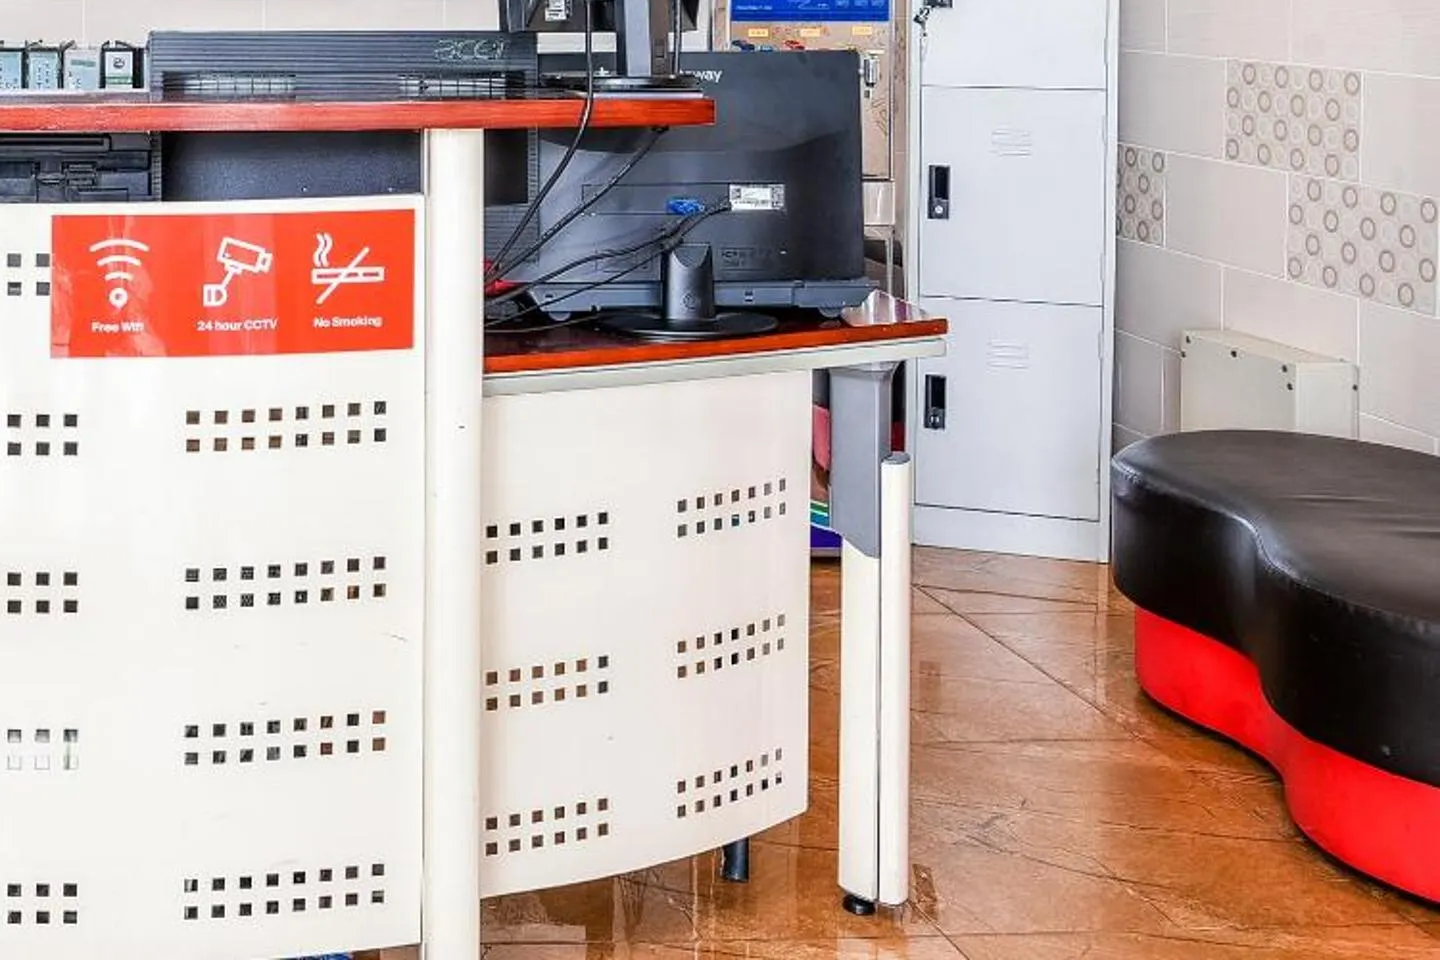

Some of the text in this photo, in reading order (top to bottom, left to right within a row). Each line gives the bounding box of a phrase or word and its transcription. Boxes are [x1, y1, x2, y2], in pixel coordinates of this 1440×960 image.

[91, 321, 120, 334] Free
[196, 318, 279, 332] 24 hour CCTV
[313, 316, 383, 328] No Smoking
